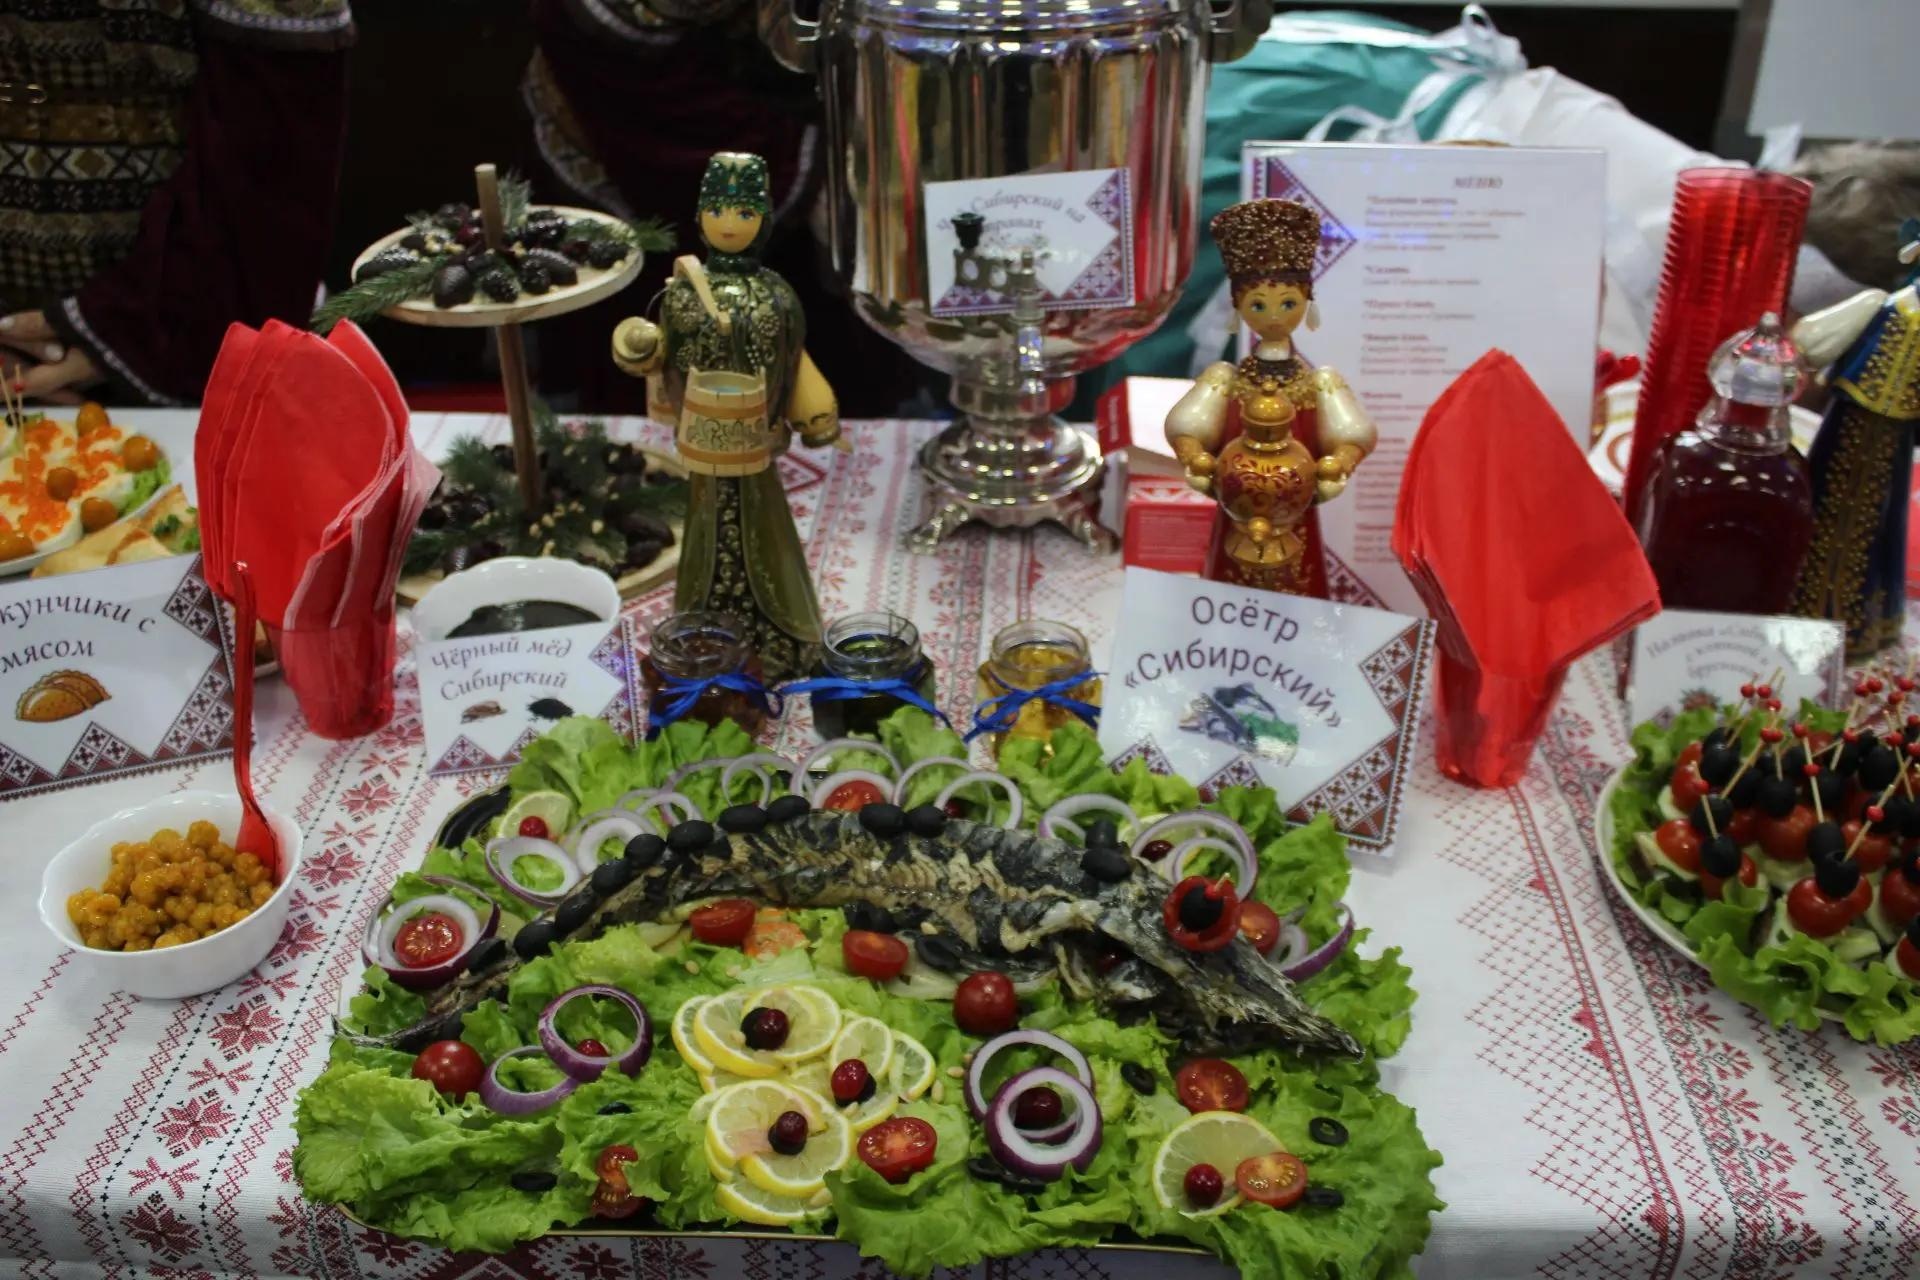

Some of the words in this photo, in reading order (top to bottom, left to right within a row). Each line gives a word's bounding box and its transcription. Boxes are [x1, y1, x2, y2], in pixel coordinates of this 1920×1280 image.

[0, 595, 131, 629] кунчики
[139, 617, 156, 633] с
[1191, 595, 1299, 643] Осётр
[2, 639, 96, 674] мясом
[432, 636, 520, 670] Чёрный
[527, 637, 573, 659] мёд
[440, 668, 570, 702] Сибирский
[1125, 638, 1342, 729] «Сибирский»
